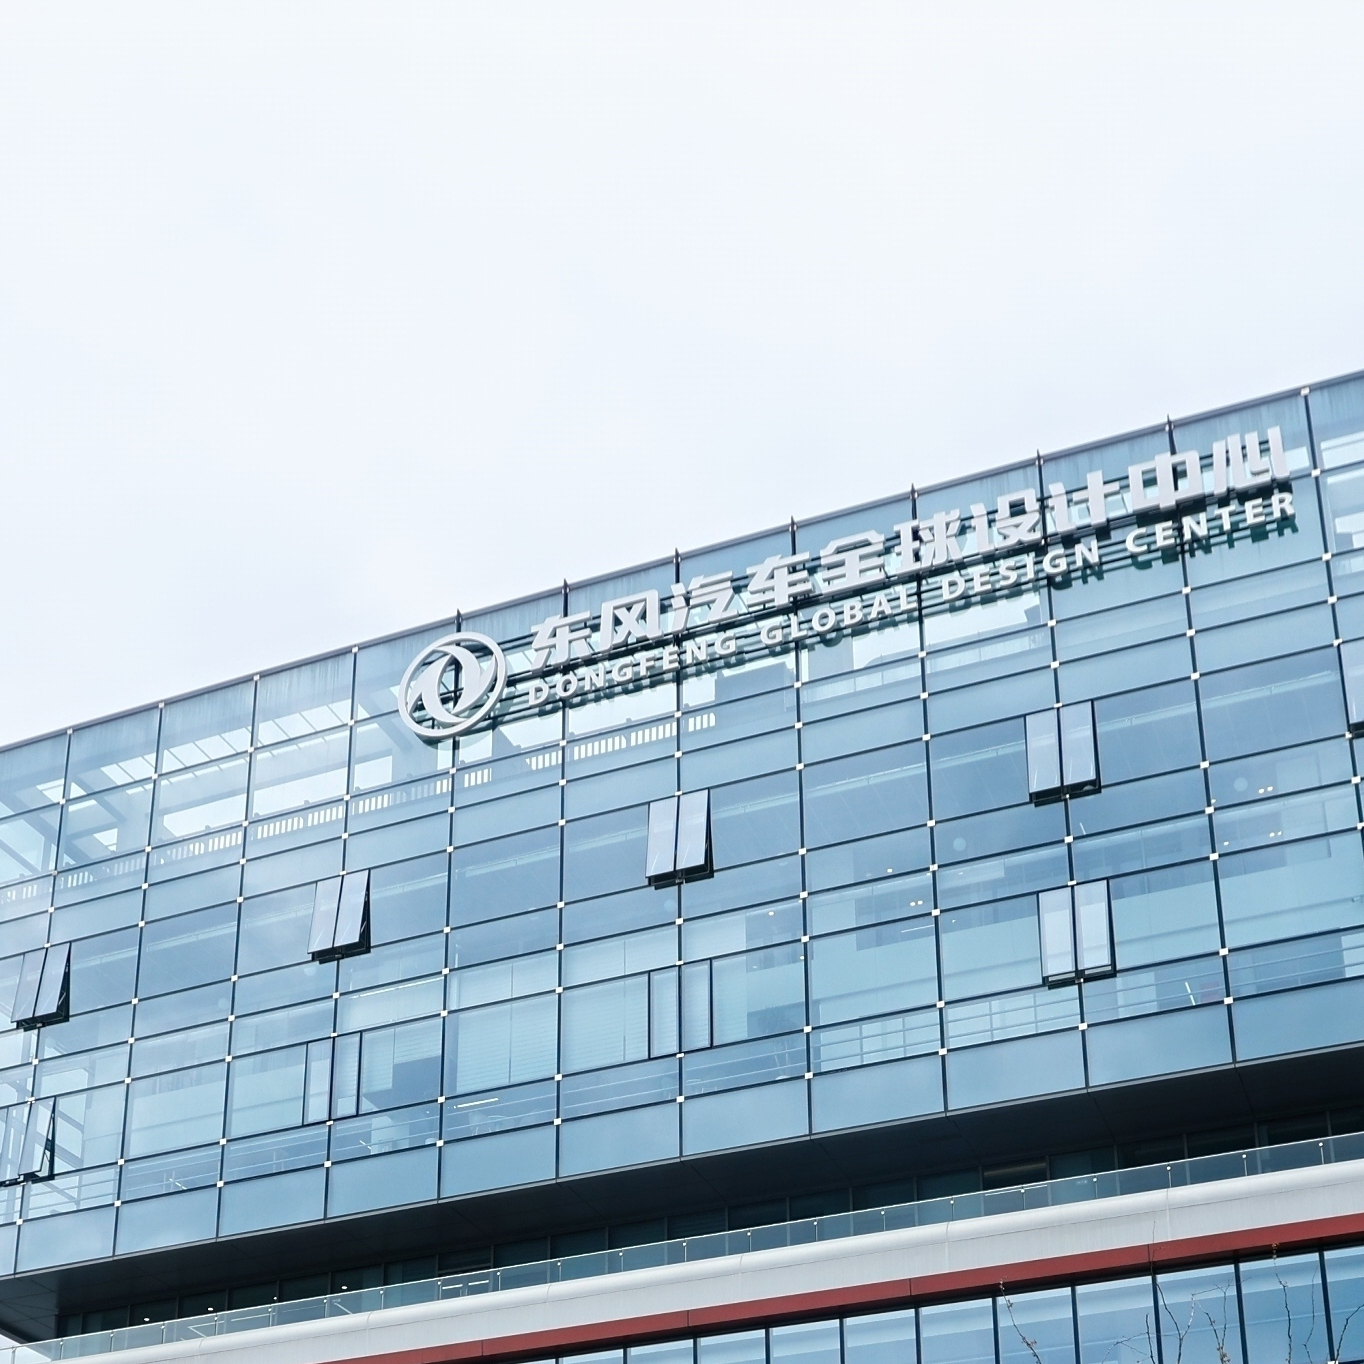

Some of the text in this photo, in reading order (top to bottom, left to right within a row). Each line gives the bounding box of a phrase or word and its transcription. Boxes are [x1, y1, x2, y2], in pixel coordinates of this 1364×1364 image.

[528, 492, 1296, 707] DONGFENG GLOBAL DESIGN CENTER
[530, 425, 1291, 671] 东风汽车全球设计中心
